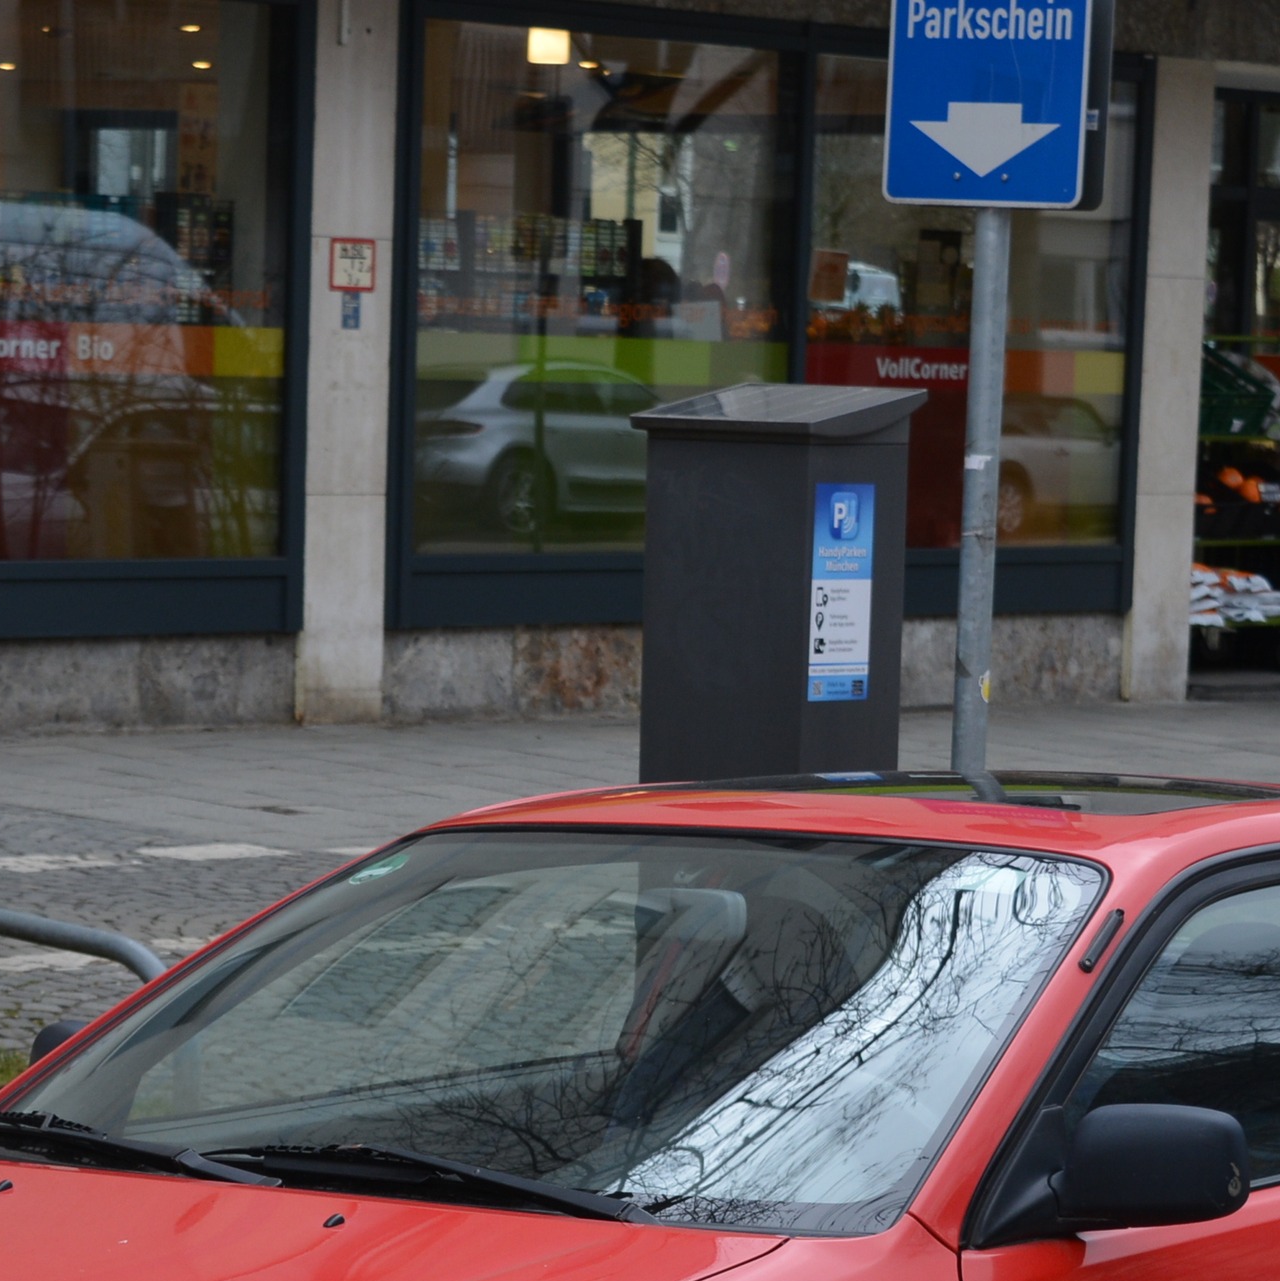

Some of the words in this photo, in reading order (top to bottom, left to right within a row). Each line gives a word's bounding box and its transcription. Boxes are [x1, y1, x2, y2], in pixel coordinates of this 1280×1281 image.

[907, 0, 1073, 40] Parkschein
[76, 335, 115, 361] Bio
[876, 356, 968, 380] VollCorner
[818, 546, 867, 560] HandyParken
[825, 560, 860, 572] München
